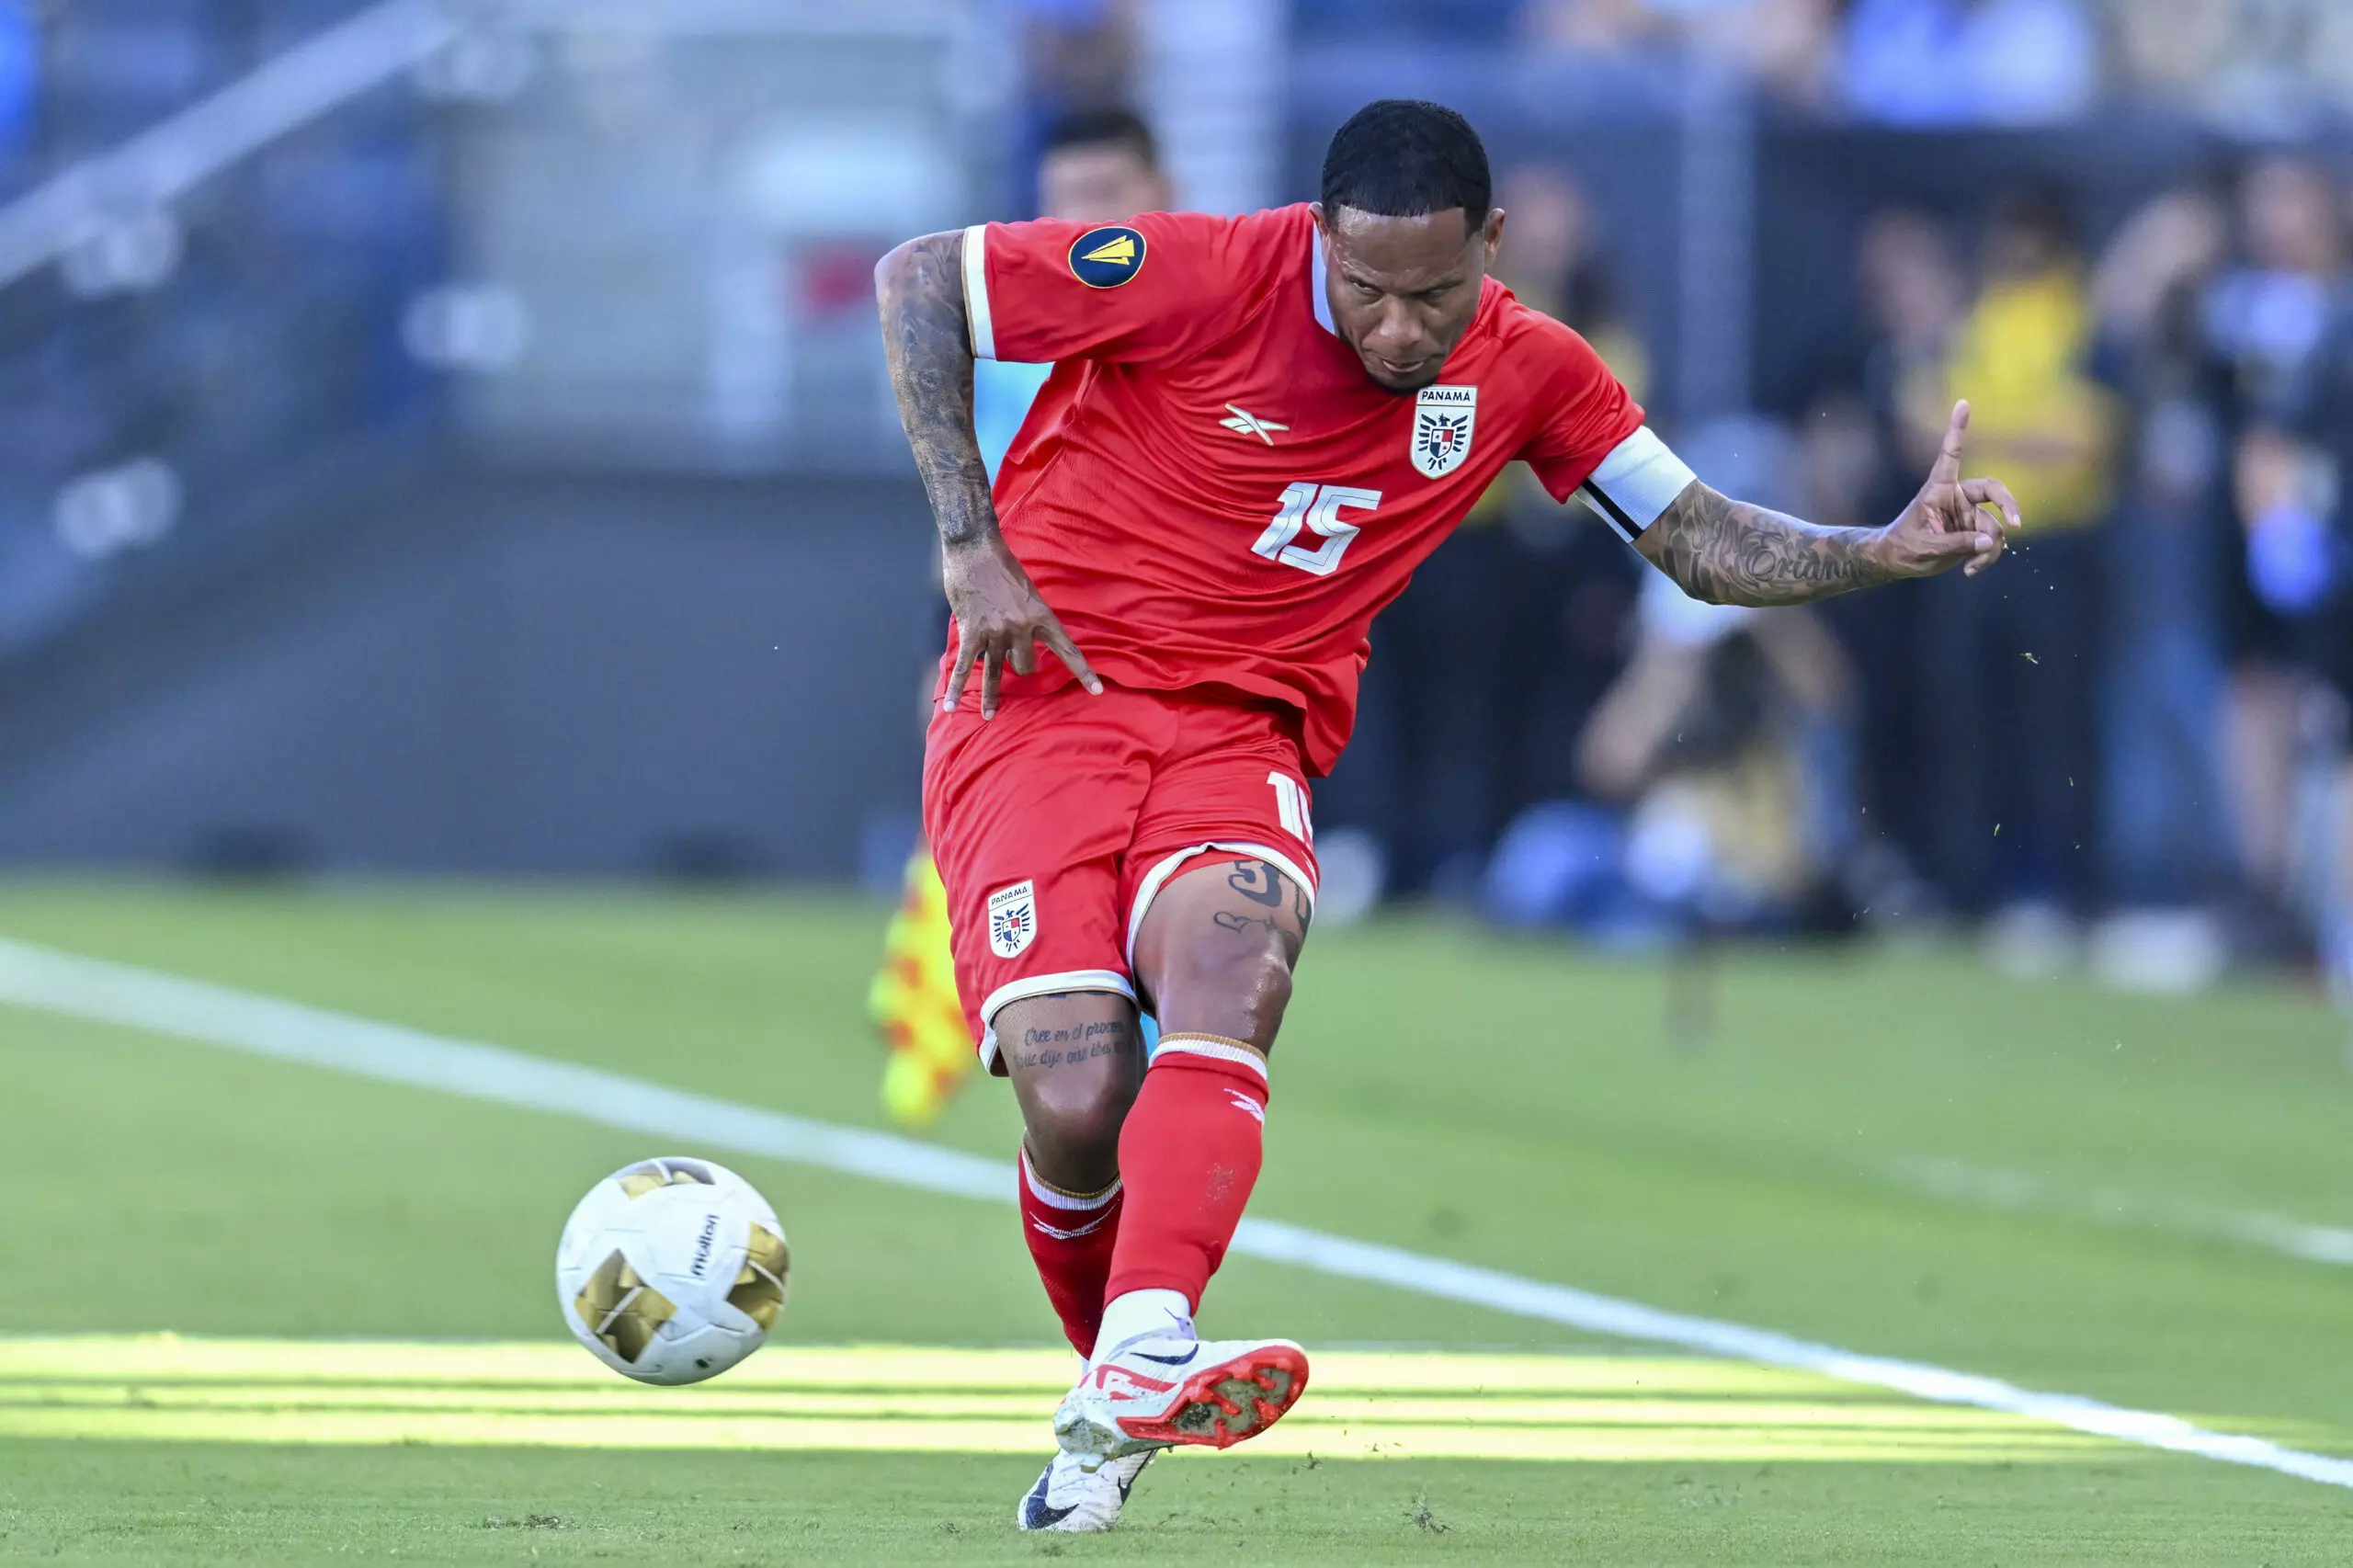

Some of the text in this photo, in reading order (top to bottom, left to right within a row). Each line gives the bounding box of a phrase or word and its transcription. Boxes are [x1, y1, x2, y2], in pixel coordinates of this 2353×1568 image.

[1422, 390, 1471, 402] PANAMÁ
[1250, 482, 1382, 575] 15
[689, 1213, 721, 1277] molten
